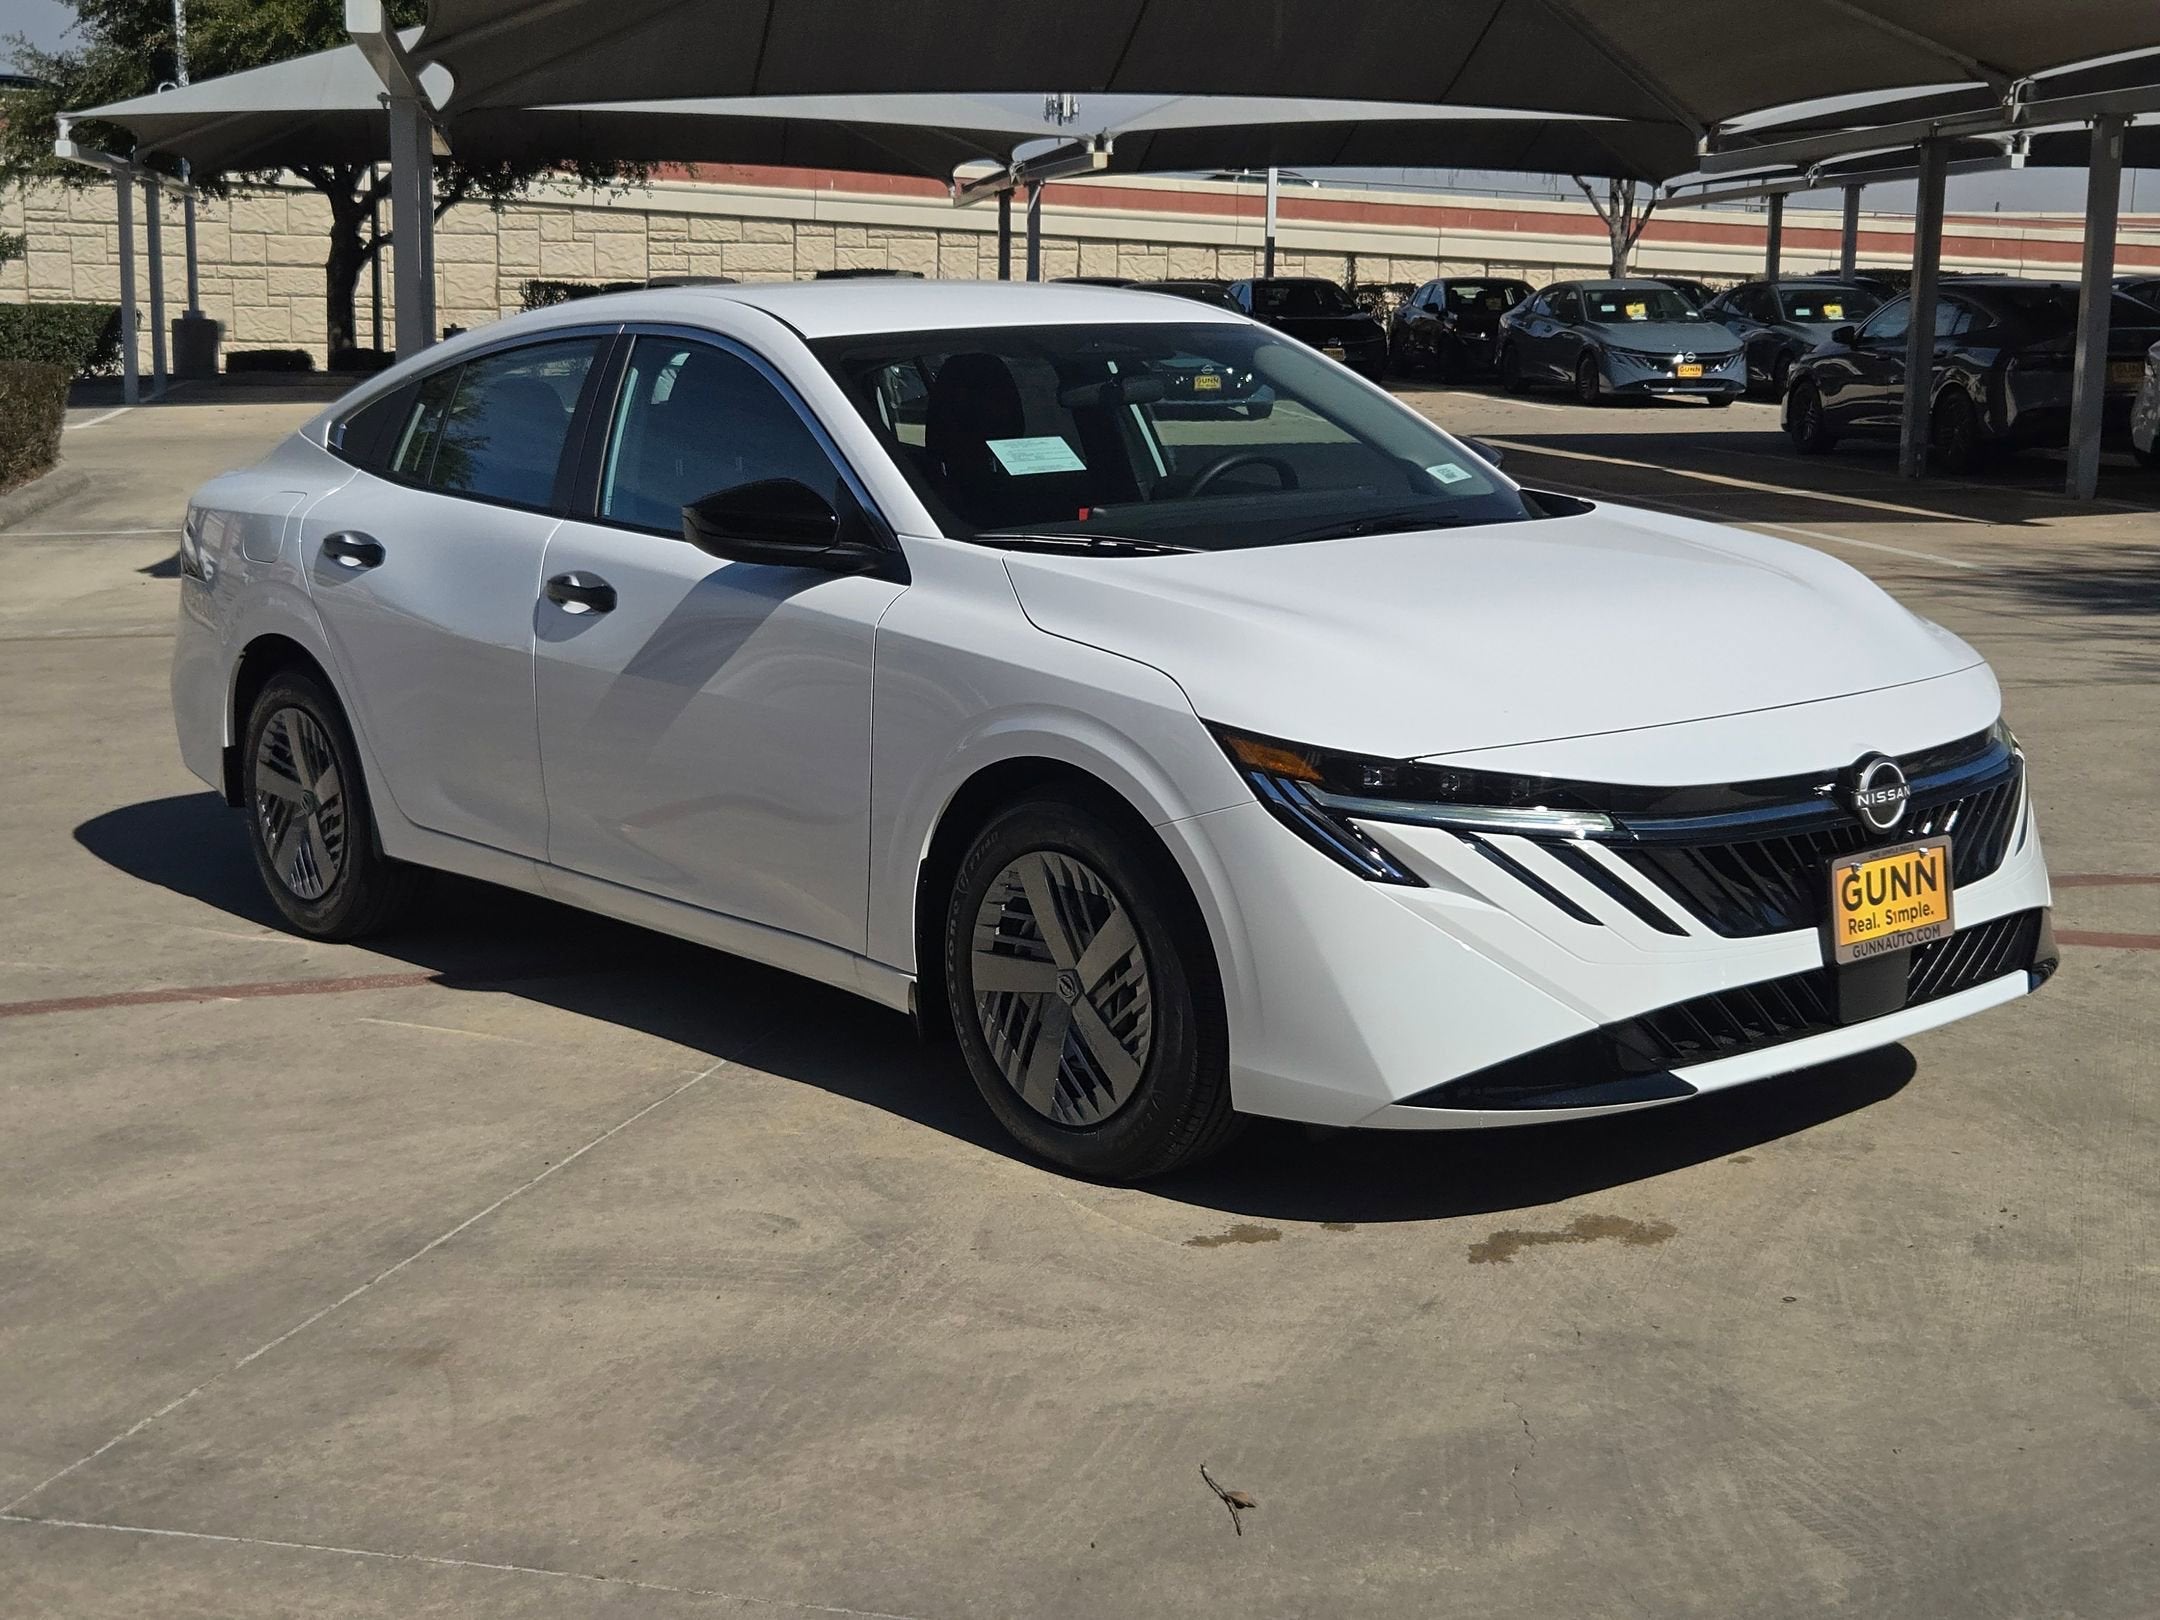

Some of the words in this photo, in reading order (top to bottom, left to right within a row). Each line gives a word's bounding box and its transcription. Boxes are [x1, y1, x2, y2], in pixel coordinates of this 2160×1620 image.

[1857, 784, 1911, 807] NISSAN
[1841, 856, 1938, 912] GUNN
[1848, 912, 1881, 935] Real.
[1852, 924, 1941, 959] GUNNAUTO.COM
